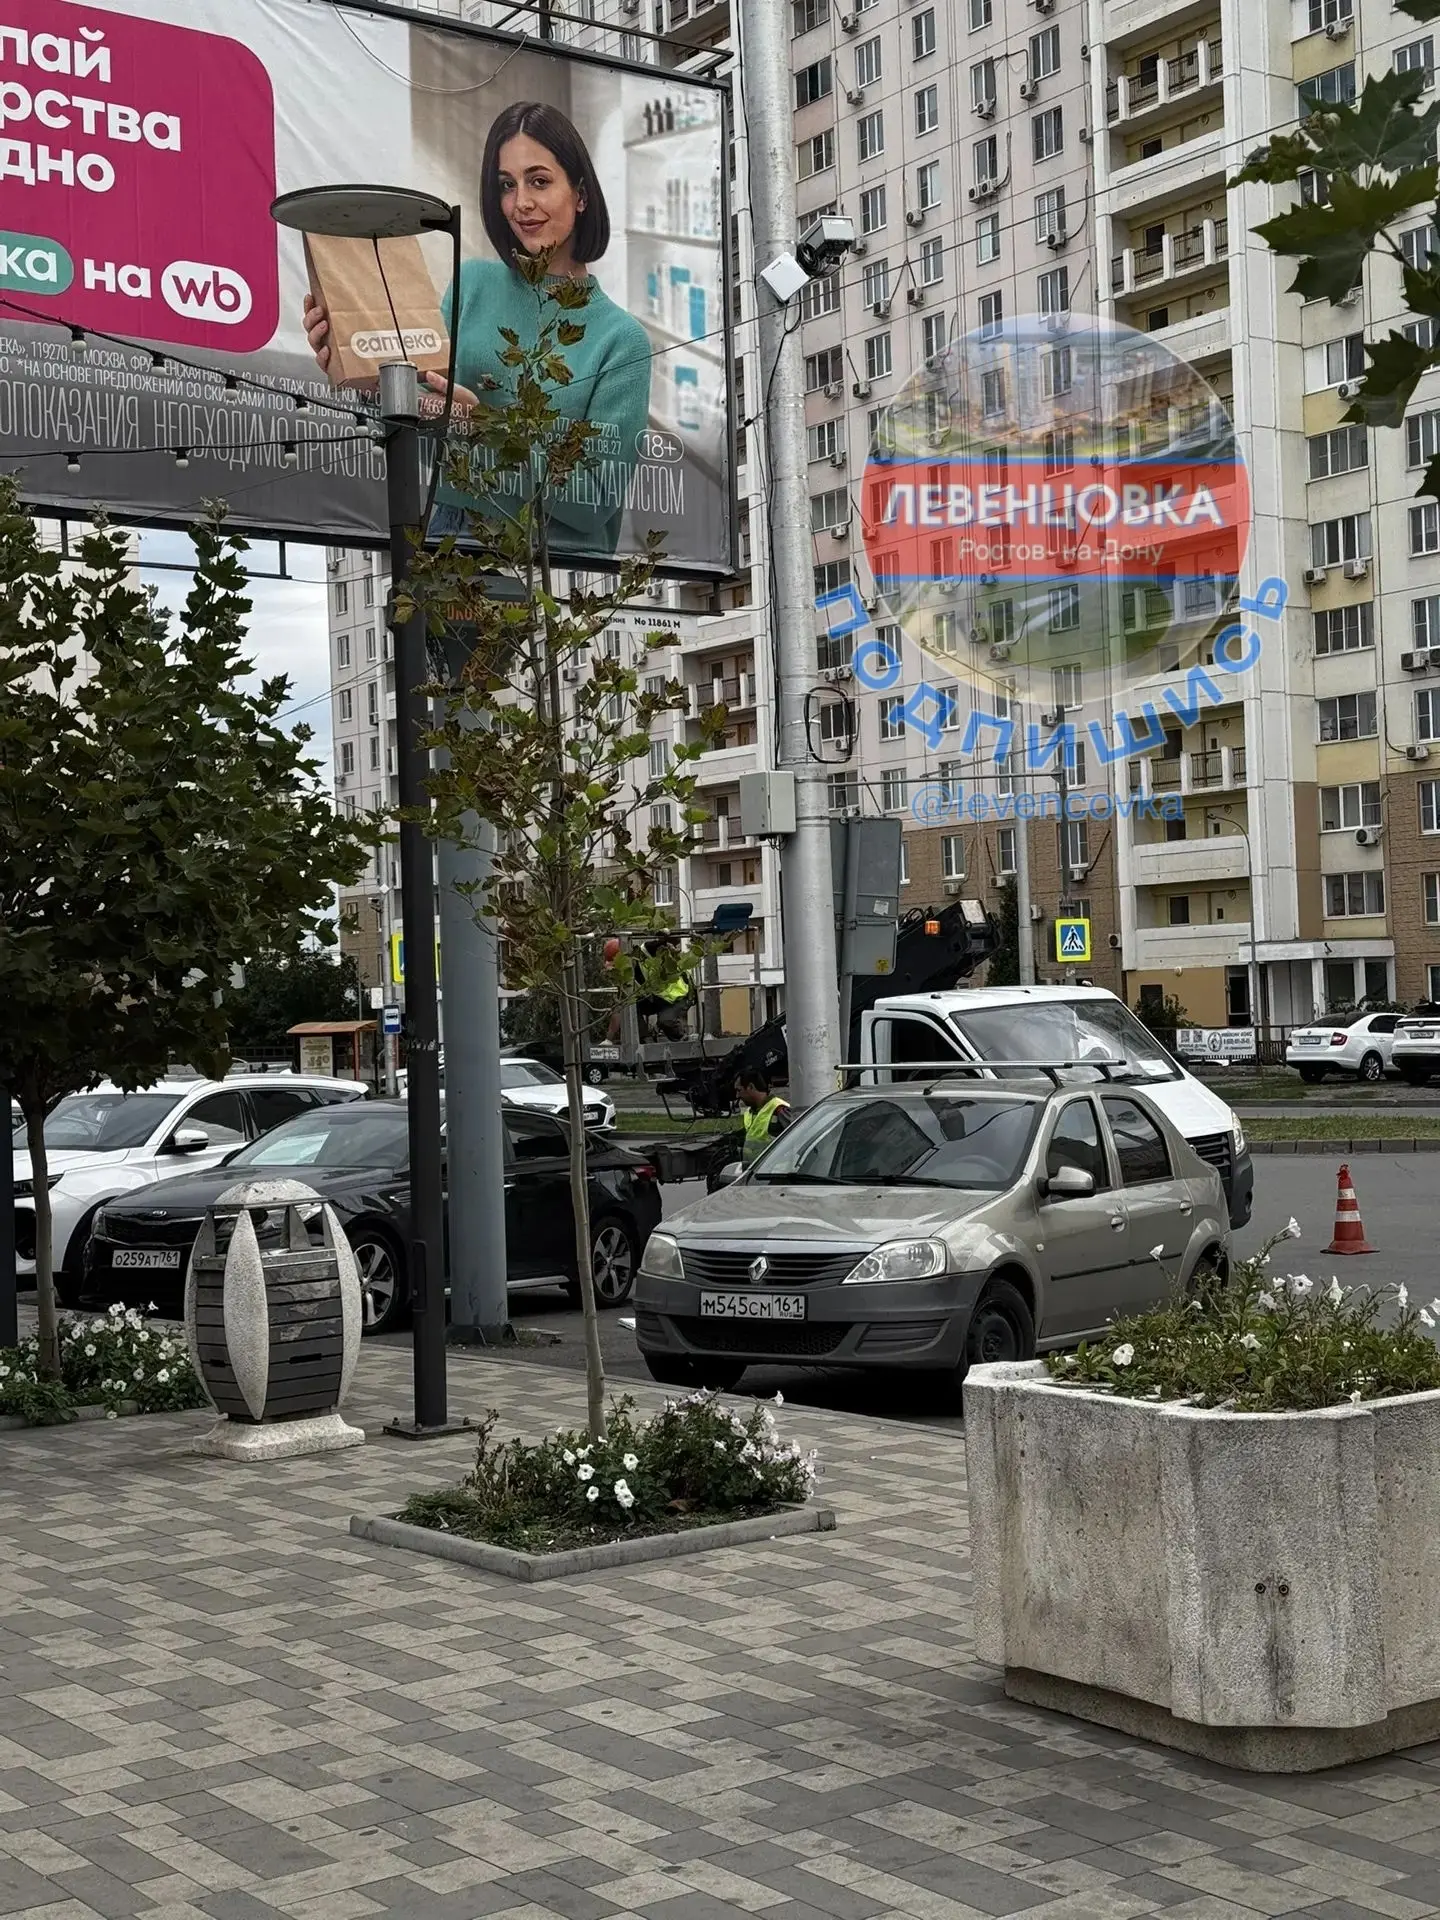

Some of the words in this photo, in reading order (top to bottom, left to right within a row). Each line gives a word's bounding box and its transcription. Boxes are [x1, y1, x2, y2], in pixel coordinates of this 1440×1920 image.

[0, 25, 111, 83] пай
[0, 81, 181, 152] рства
[0, 138, 115, 193] дно
[0, 245, 57, 283] ка
[83, 258, 152, 299] на
[172, 271, 241, 313] wb
[31, 341, 70, 364] 119270,
[84, 349, 128, 371] МОСКВА,
[130, 356, 200, 382] ФРУЕНСКАЯ
[43, 362, 91, 384] ОСНОВЕ
[186, 381, 201, 399] СО
[204, 384, 265, 409] СКИКАМИ
[268, 394, 284, 411] ПО
[153, 399, 289, 472] НЕОБХОДИМО
[554, 456, 685, 515] ЕЦИАЛИСТОМ
[643, 434, 677, 458] 18+
